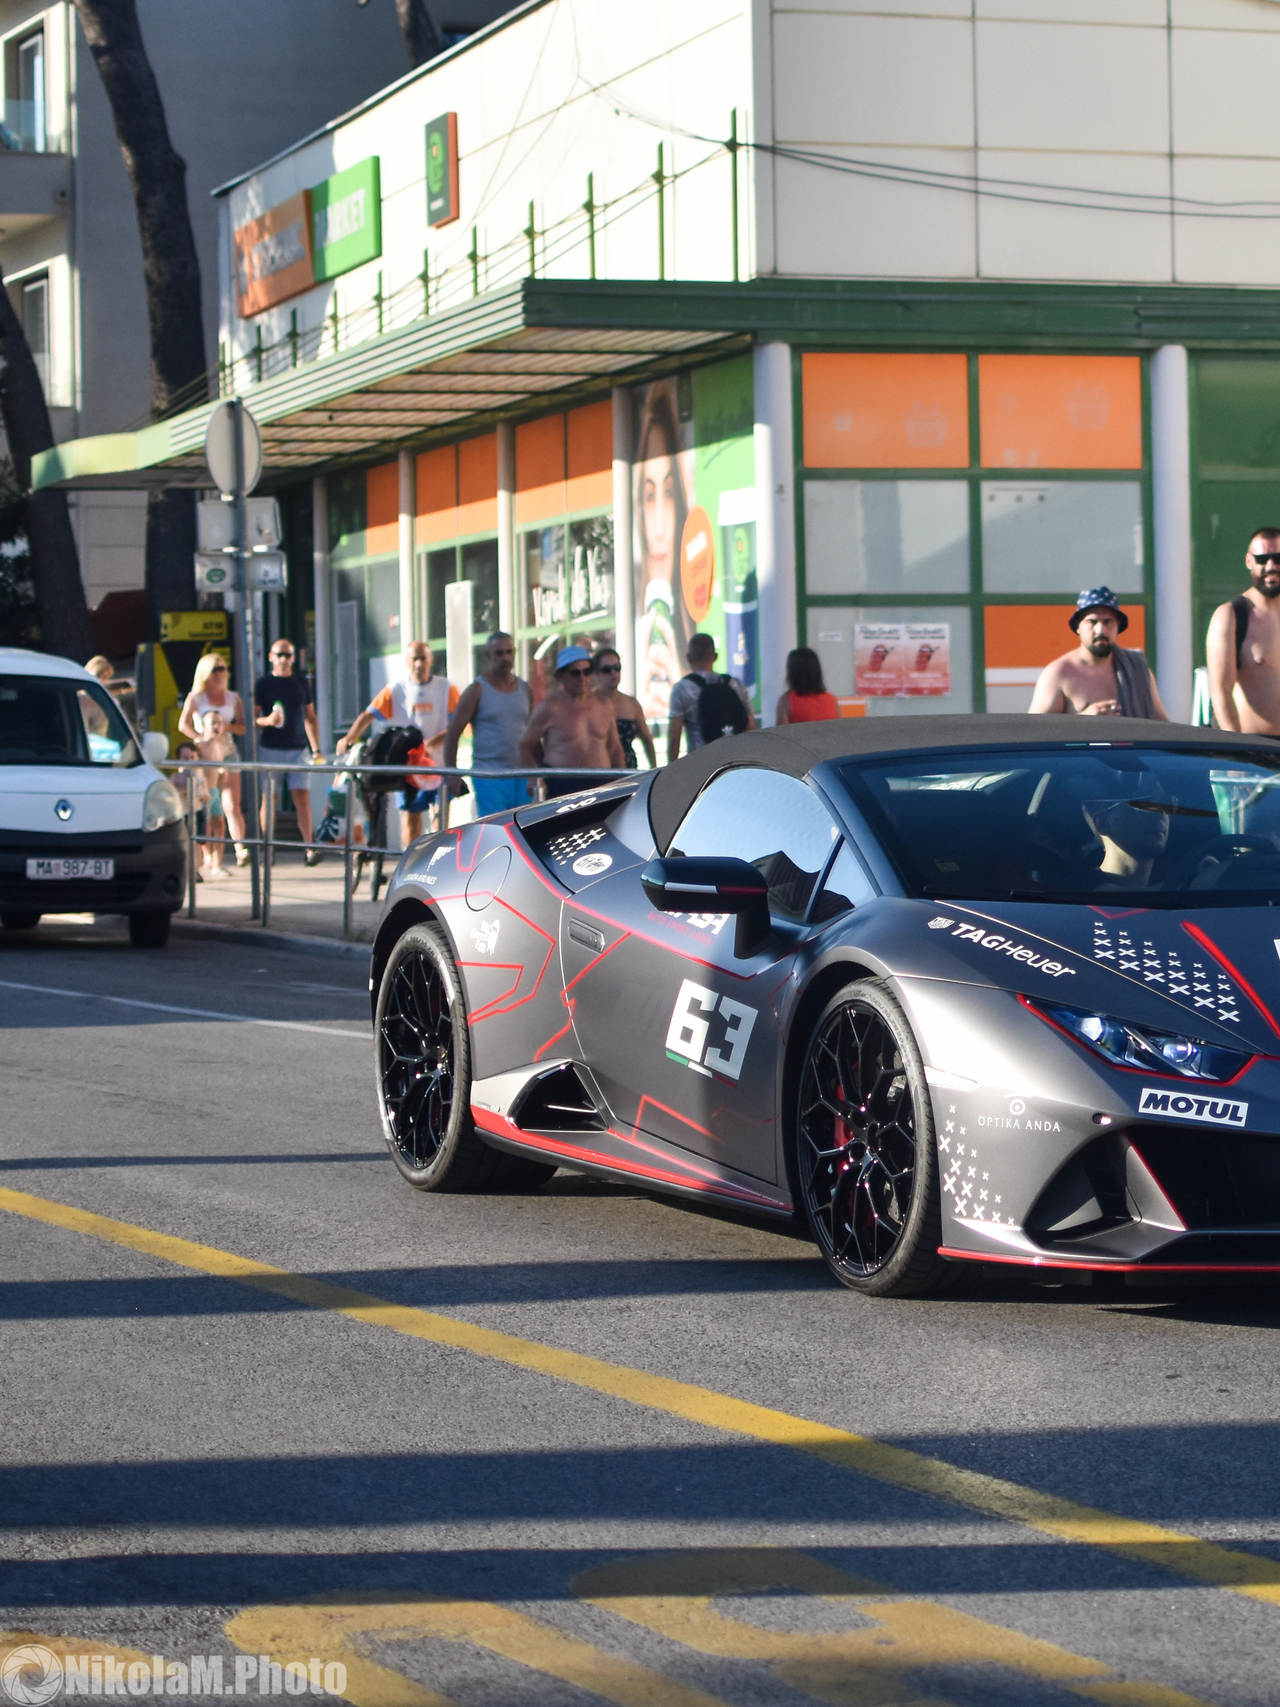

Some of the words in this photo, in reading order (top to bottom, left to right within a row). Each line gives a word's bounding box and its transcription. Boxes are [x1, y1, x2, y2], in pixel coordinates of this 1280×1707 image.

[665, 978, 759, 1081] 63
[1142, 1092, 1244, 1122] MOTUL
[977, 1115, 1020, 1130] OPTIKA
[1025, 1119, 1061, 1133] ANDA
